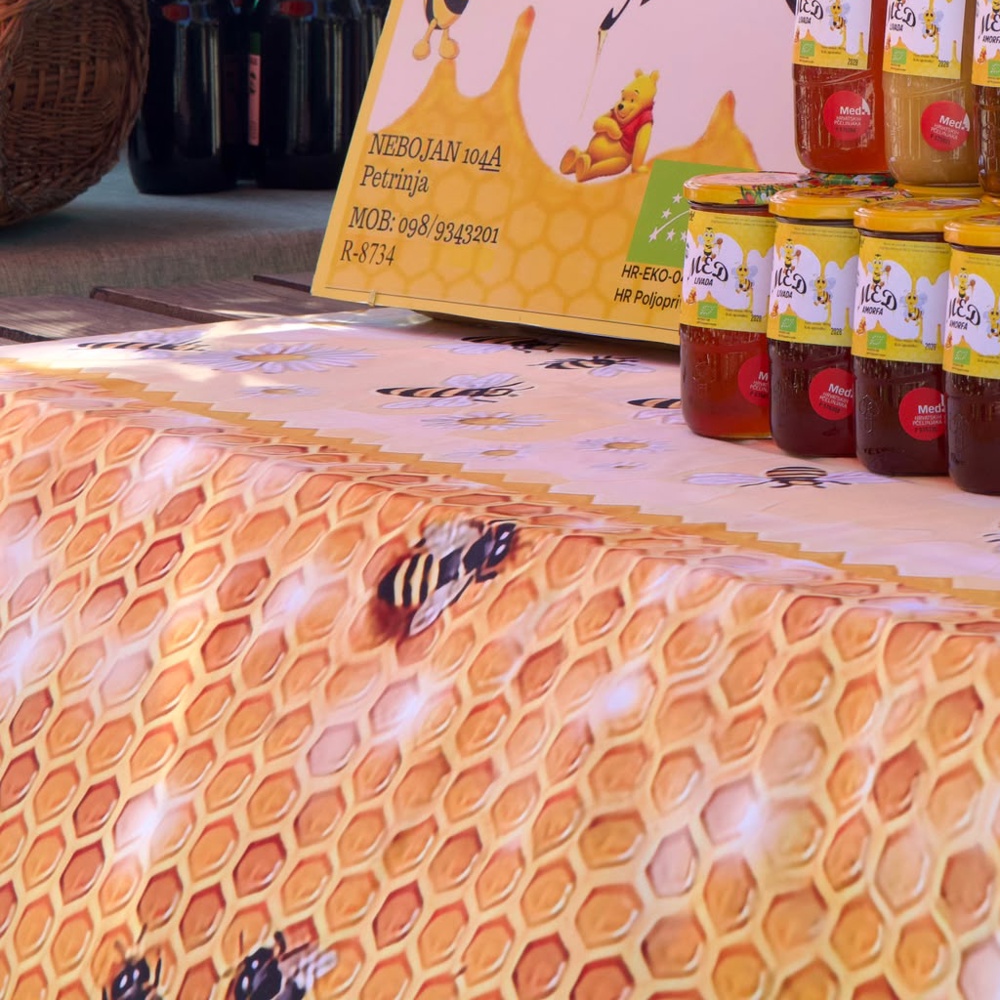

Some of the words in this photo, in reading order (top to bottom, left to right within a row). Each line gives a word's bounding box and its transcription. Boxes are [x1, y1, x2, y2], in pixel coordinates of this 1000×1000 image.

[368, 133, 463, 164] NEBOJAN
[461, 145, 502, 172] 104A
[360, 165, 429, 197] Petrinja
[348, 206, 396, 233] MOB:
[398, 214, 500, 245] 098/9343201
[340, 240, 396, 266] R-8734
[621, 264, 684, 285] HR-EKO-0
[688, 255, 729, 282] MED
[773, 268, 807, 295] MED
[693, 277, 713, 287] LIVADA
[777, 289, 793, 299] LIVADA
[614, 287, 633, 304] HR
[633, 290, 681, 311] Poljopri
[859, 284, 897, 311] MED
[862, 304, 884, 316] AMORFA
